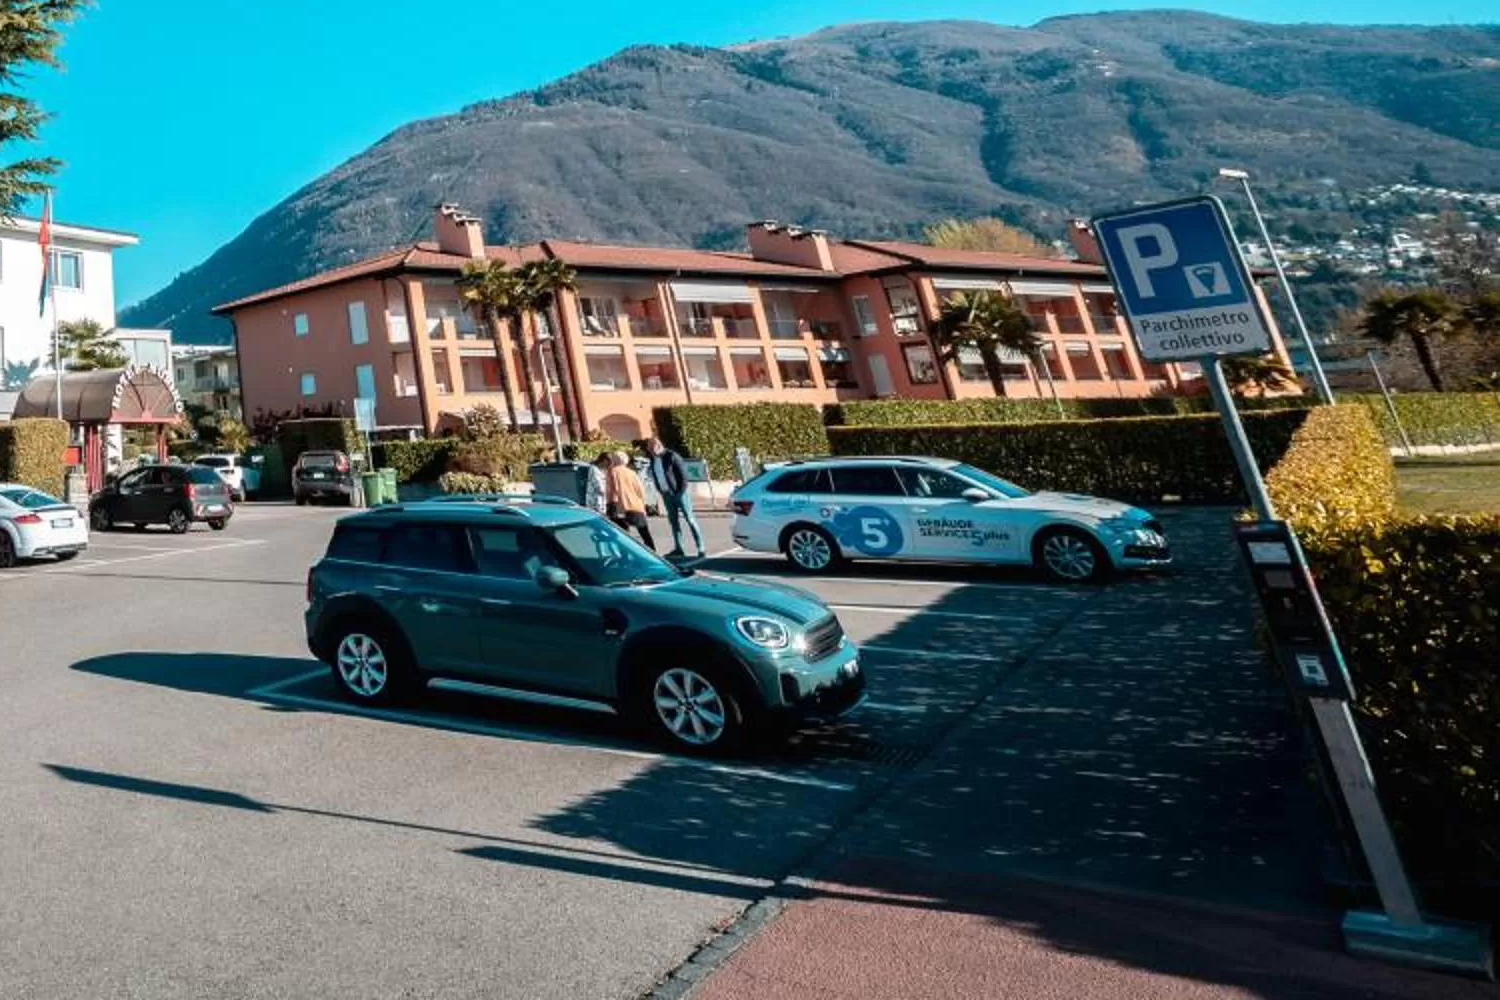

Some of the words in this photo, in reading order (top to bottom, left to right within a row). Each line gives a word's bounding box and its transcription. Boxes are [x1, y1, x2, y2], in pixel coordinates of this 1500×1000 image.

[1116, 223, 1178, 299] P
[1141, 312, 1249, 334] Parchimetro
[1160, 331, 1244, 350] collettivo
